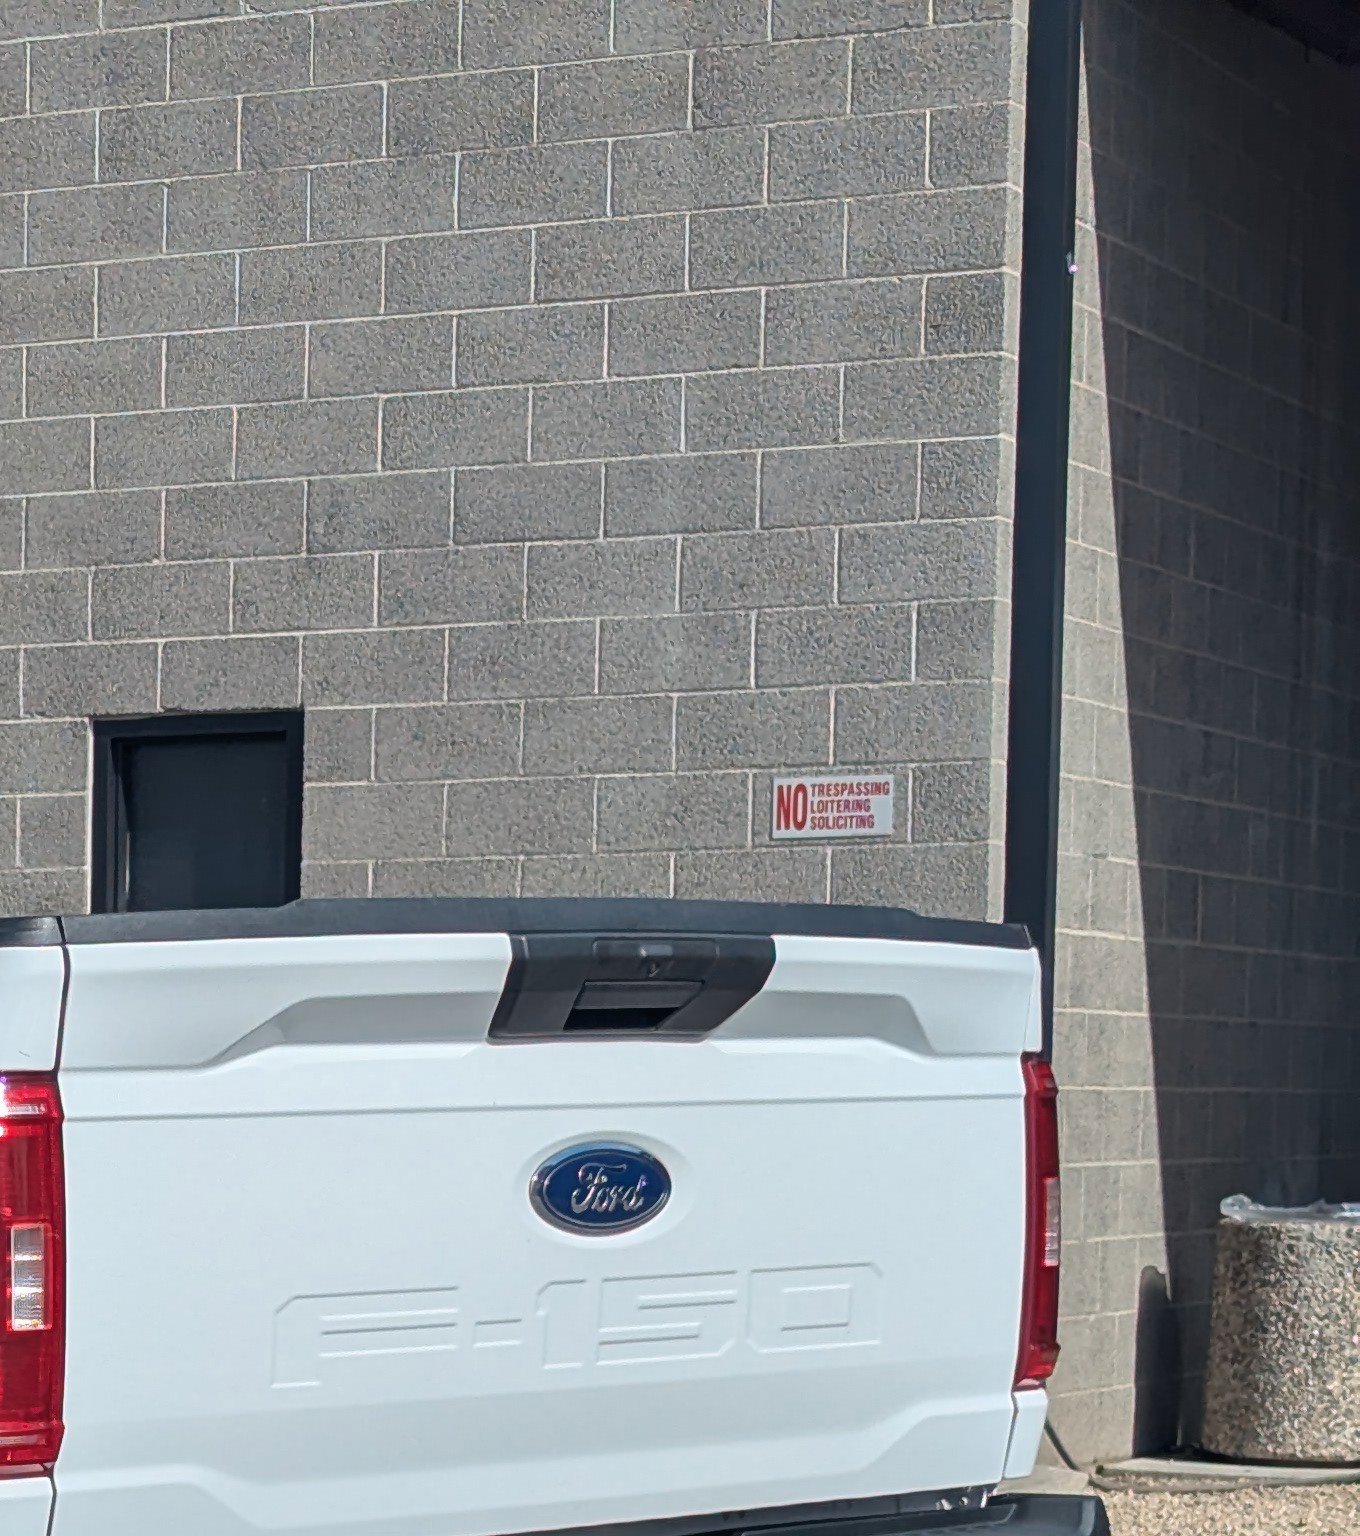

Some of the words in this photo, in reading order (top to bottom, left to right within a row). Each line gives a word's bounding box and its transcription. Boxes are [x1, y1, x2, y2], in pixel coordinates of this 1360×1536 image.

[810, 781, 890, 797] TRESPASSING
[776, 783, 808, 831] NO
[810, 798, 871, 814] LOITERING
[810, 814, 875, 830] SOLICITING
[570, 1162, 648, 1214] Ford
[270, 1261, 884, 1390] F-150
